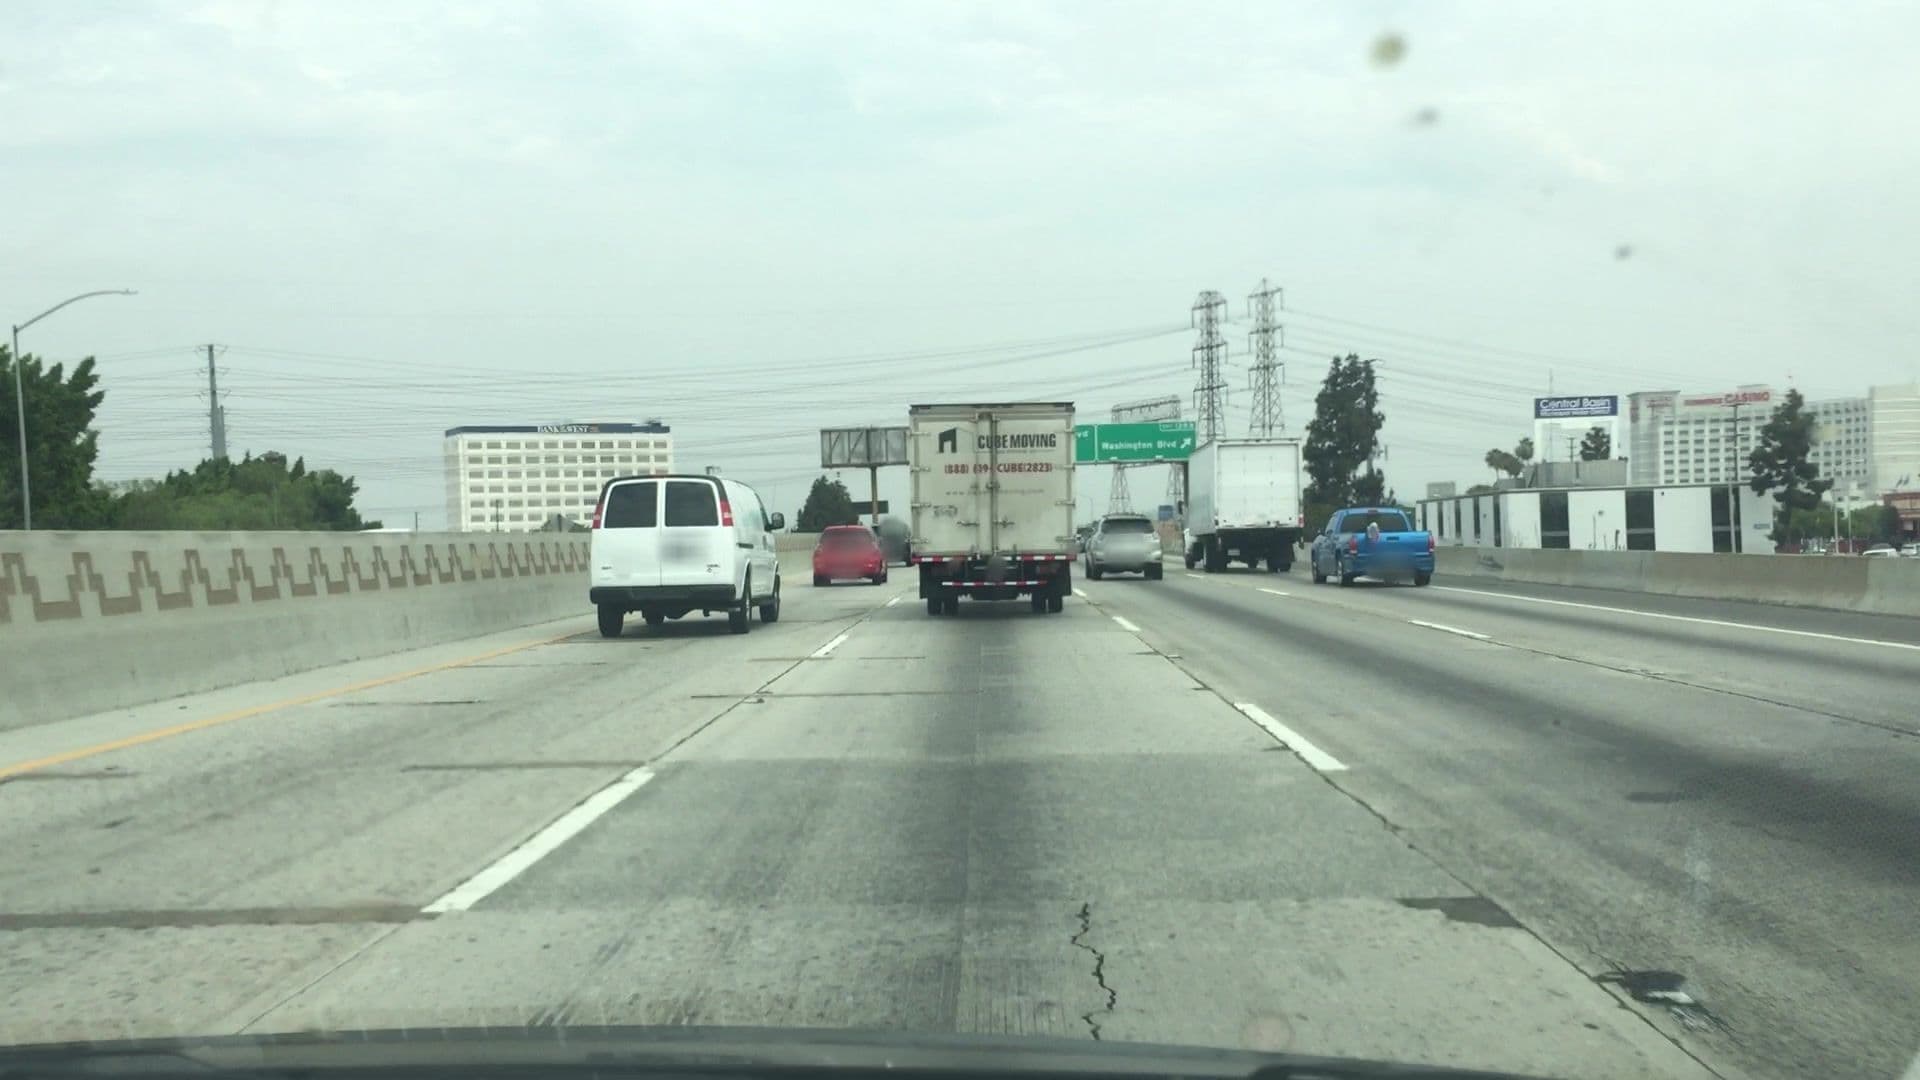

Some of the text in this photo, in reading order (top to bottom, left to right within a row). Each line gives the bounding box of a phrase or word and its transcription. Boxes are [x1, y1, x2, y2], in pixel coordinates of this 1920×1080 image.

[1540, 399, 1580, 409] Central
[977, 433, 1057, 449] CUBE MOVING
[1101, 440, 1177, 451] Washington Blvd
